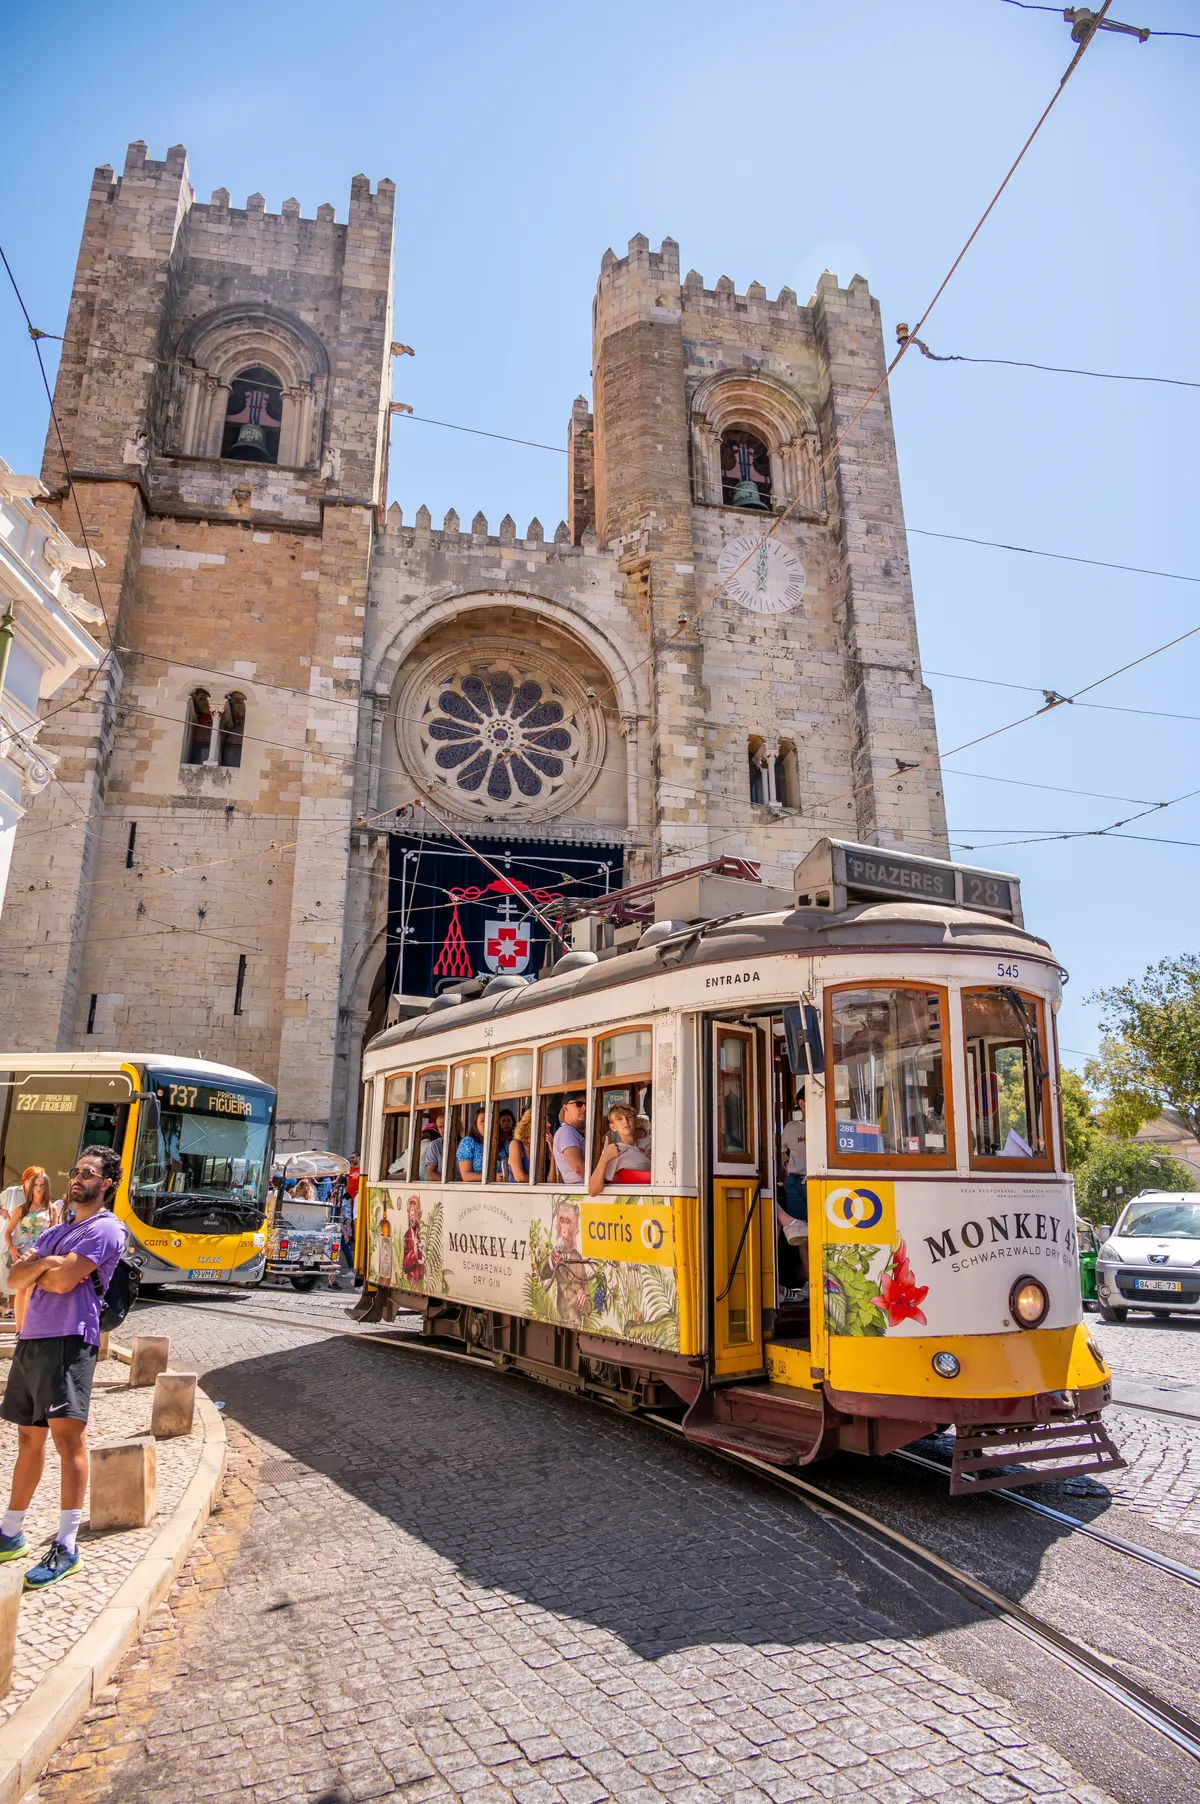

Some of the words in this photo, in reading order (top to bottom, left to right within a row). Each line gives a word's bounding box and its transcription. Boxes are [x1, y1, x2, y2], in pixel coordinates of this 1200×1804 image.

[853, 860, 944, 894] PRAZERES
[970, 878, 1000, 906] 28
[997, 963, 1019, 978] 545
[705, 971, 761, 988] ENTRADA
[16, 1093, 40, 1111] 737
[169, 1084, 198, 1108] 737
[40, 1101, 73, 1112] FIGUEIRA
[208, 1096, 253, 1117] FIGUEIRA
[840, 1124, 855, 1133] 28E
[839, 1137, 855, 1149] 03
[588, 1215, 632, 1243] carris
[144, 1238, 169, 1247] carris
[448, 1231, 507, 1259] MONKEY
[511, 1239, 527, 1261] 47
[923, 1213, 1061, 1264] MONKEY
[1064, 1228, 1076, 1256] 47
[197, 1256, 222, 1264] MAN
[952, 1245, 1041, 1273] SCHWARZWALD
[1045, 1247, 1061, 1260] DRY
[1062, 1254, 1072, 1268] GIN
[462, 1260, 512, 1277] SCHWARZWALD
[472, 1275, 486, 1286] DRY
[488, 1278, 501, 1288] GIN
